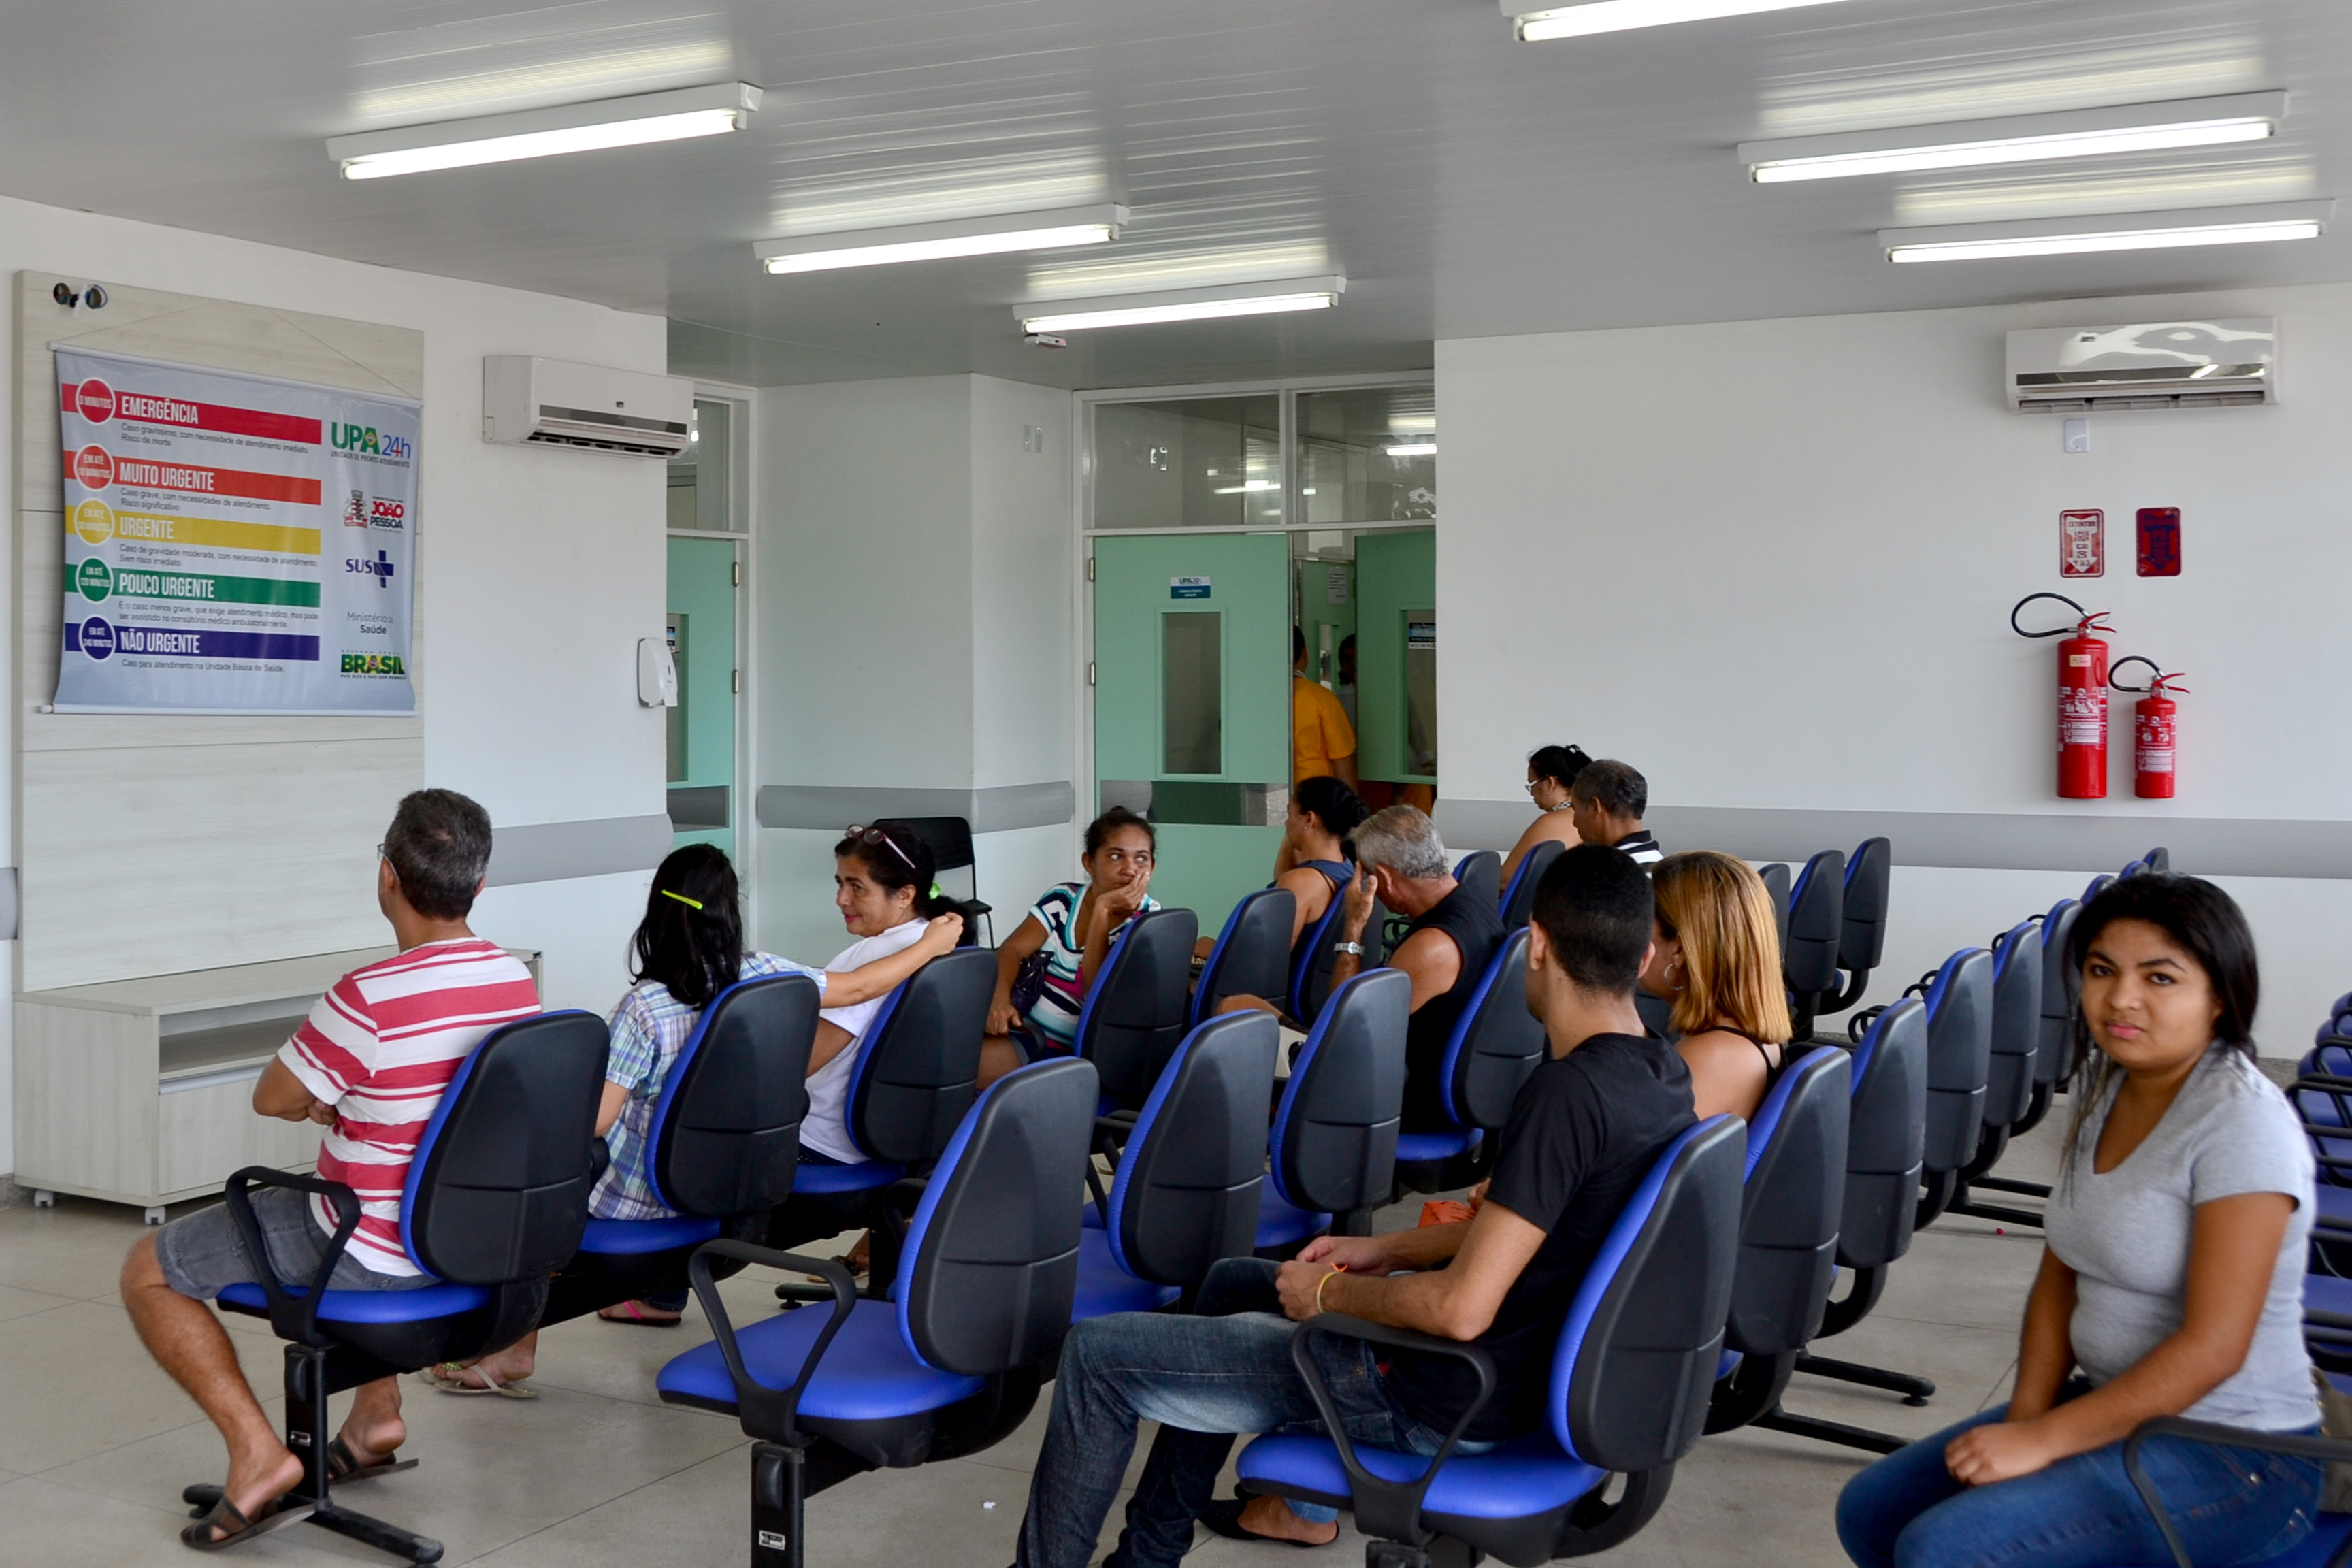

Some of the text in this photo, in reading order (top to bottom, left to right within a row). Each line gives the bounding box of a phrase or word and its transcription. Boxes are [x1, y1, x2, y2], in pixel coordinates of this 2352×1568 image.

[85, 396, 112, 409] MINUTOS
[121, 395, 199, 424] EMERGÊNCIA
[121, 433, 140, 442] Risco
[152, 437, 171, 446] morte
[122, 423, 139, 432] Caso
[195, 434, 233, 444] necessidade
[245, 440, 282, 451] atendimento
[331, 421, 411, 459] UPA 24h
[84, 454, 93, 463] EM
[354, 453, 360, 461] DE
[120, 462, 214, 491] MUITO URGENTE
[121, 488, 139, 497] Caso
[178, 495, 221, 506] necessidades
[121, 498, 180, 511] Risco significativo
[371, 500, 404, 519] JOÃO
[120, 516, 174, 540] URGENTE
[370, 516, 404, 529] PESSOA
[120, 544, 137, 553] Caso
[139, 545, 146, 553] de
[148, 546, 180, 557] gravidade
[233, 554, 270, 564] necessidade
[120, 554, 181, 566] Sem risco imediato
[86, 566, 93, 575] EM
[346, 559, 372, 574] SUS
[118, 573, 214, 598] POUCO URGENTE
[131, 613, 160, 621] assistido
[172, 615, 206, 624] consultório
[208, 616, 230, 625] médico
[209, 608, 225, 616] exige
[227, 608, 263, 617] atendimento
[304, 612, 319, 620] pode
[347, 612, 387, 623] Ministério
[89, 627, 96, 636] EM
[360, 625, 387, 634] Saúde
[120, 628, 201, 654] NÃO URGENTE
[122, 659, 137, 667] Caso
[154, 660, 194, 670] atendimento
[205, 662, 231, 671] Unidade
[233, 663, 252, 672] Básica
[341, 654, 406, 674] BRASIL
